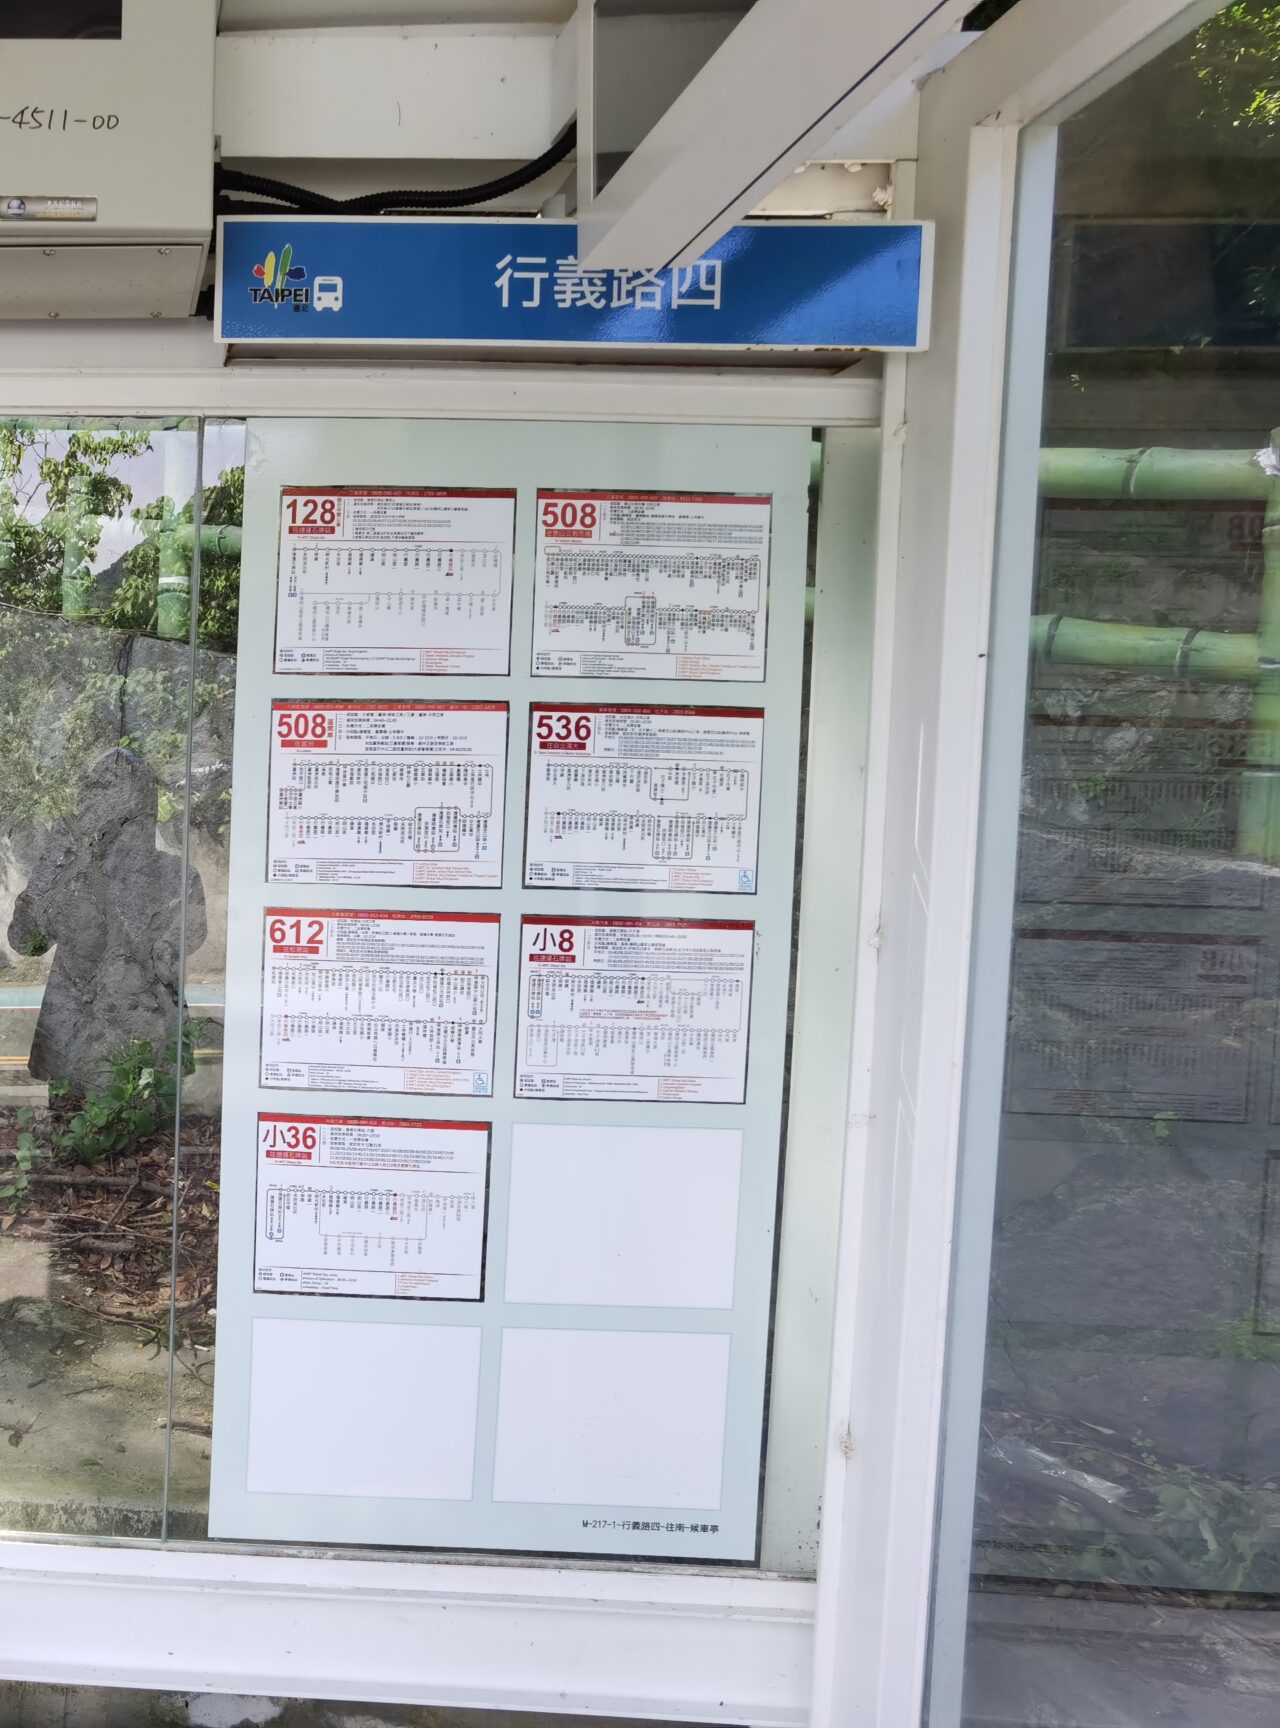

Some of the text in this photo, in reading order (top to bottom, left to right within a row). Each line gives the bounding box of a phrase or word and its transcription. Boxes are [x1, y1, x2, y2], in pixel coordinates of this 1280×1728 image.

[494, 254, 722, 310] 行義路四
[248, 287, 310, 304] TAIPEI
[286, 498, 335, 525] 128
[542, 502, 597, 528] 508
[277, 713, 327, 738] 508
[536, 714, 591, 741] 536
[269, 918, 324, 944] 612
[532, 927, 574, 953] 小8
[262, 1124, 317, 1150] 小36
